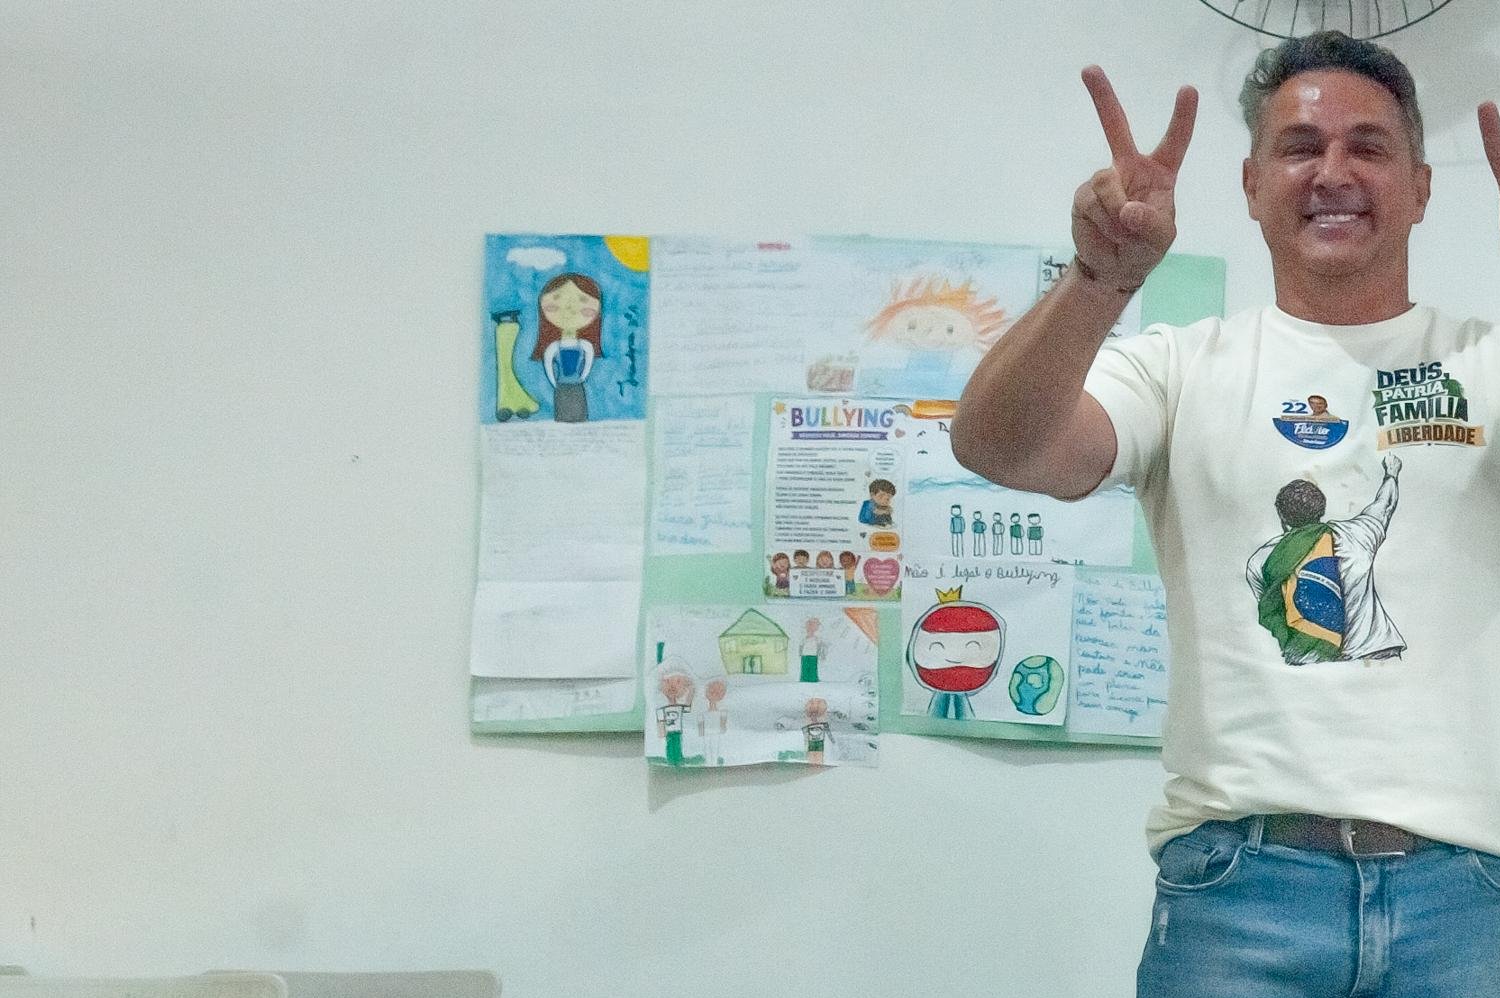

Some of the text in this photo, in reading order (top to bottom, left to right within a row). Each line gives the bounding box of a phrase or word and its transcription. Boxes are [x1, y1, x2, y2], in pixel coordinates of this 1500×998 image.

[791, 406, 894, 428] BULLYING
[1281, 402, 1309, 414] 22
[1386, 424, 1476, 446] LIBERDADE
[952, 564, 981, 582] legal
